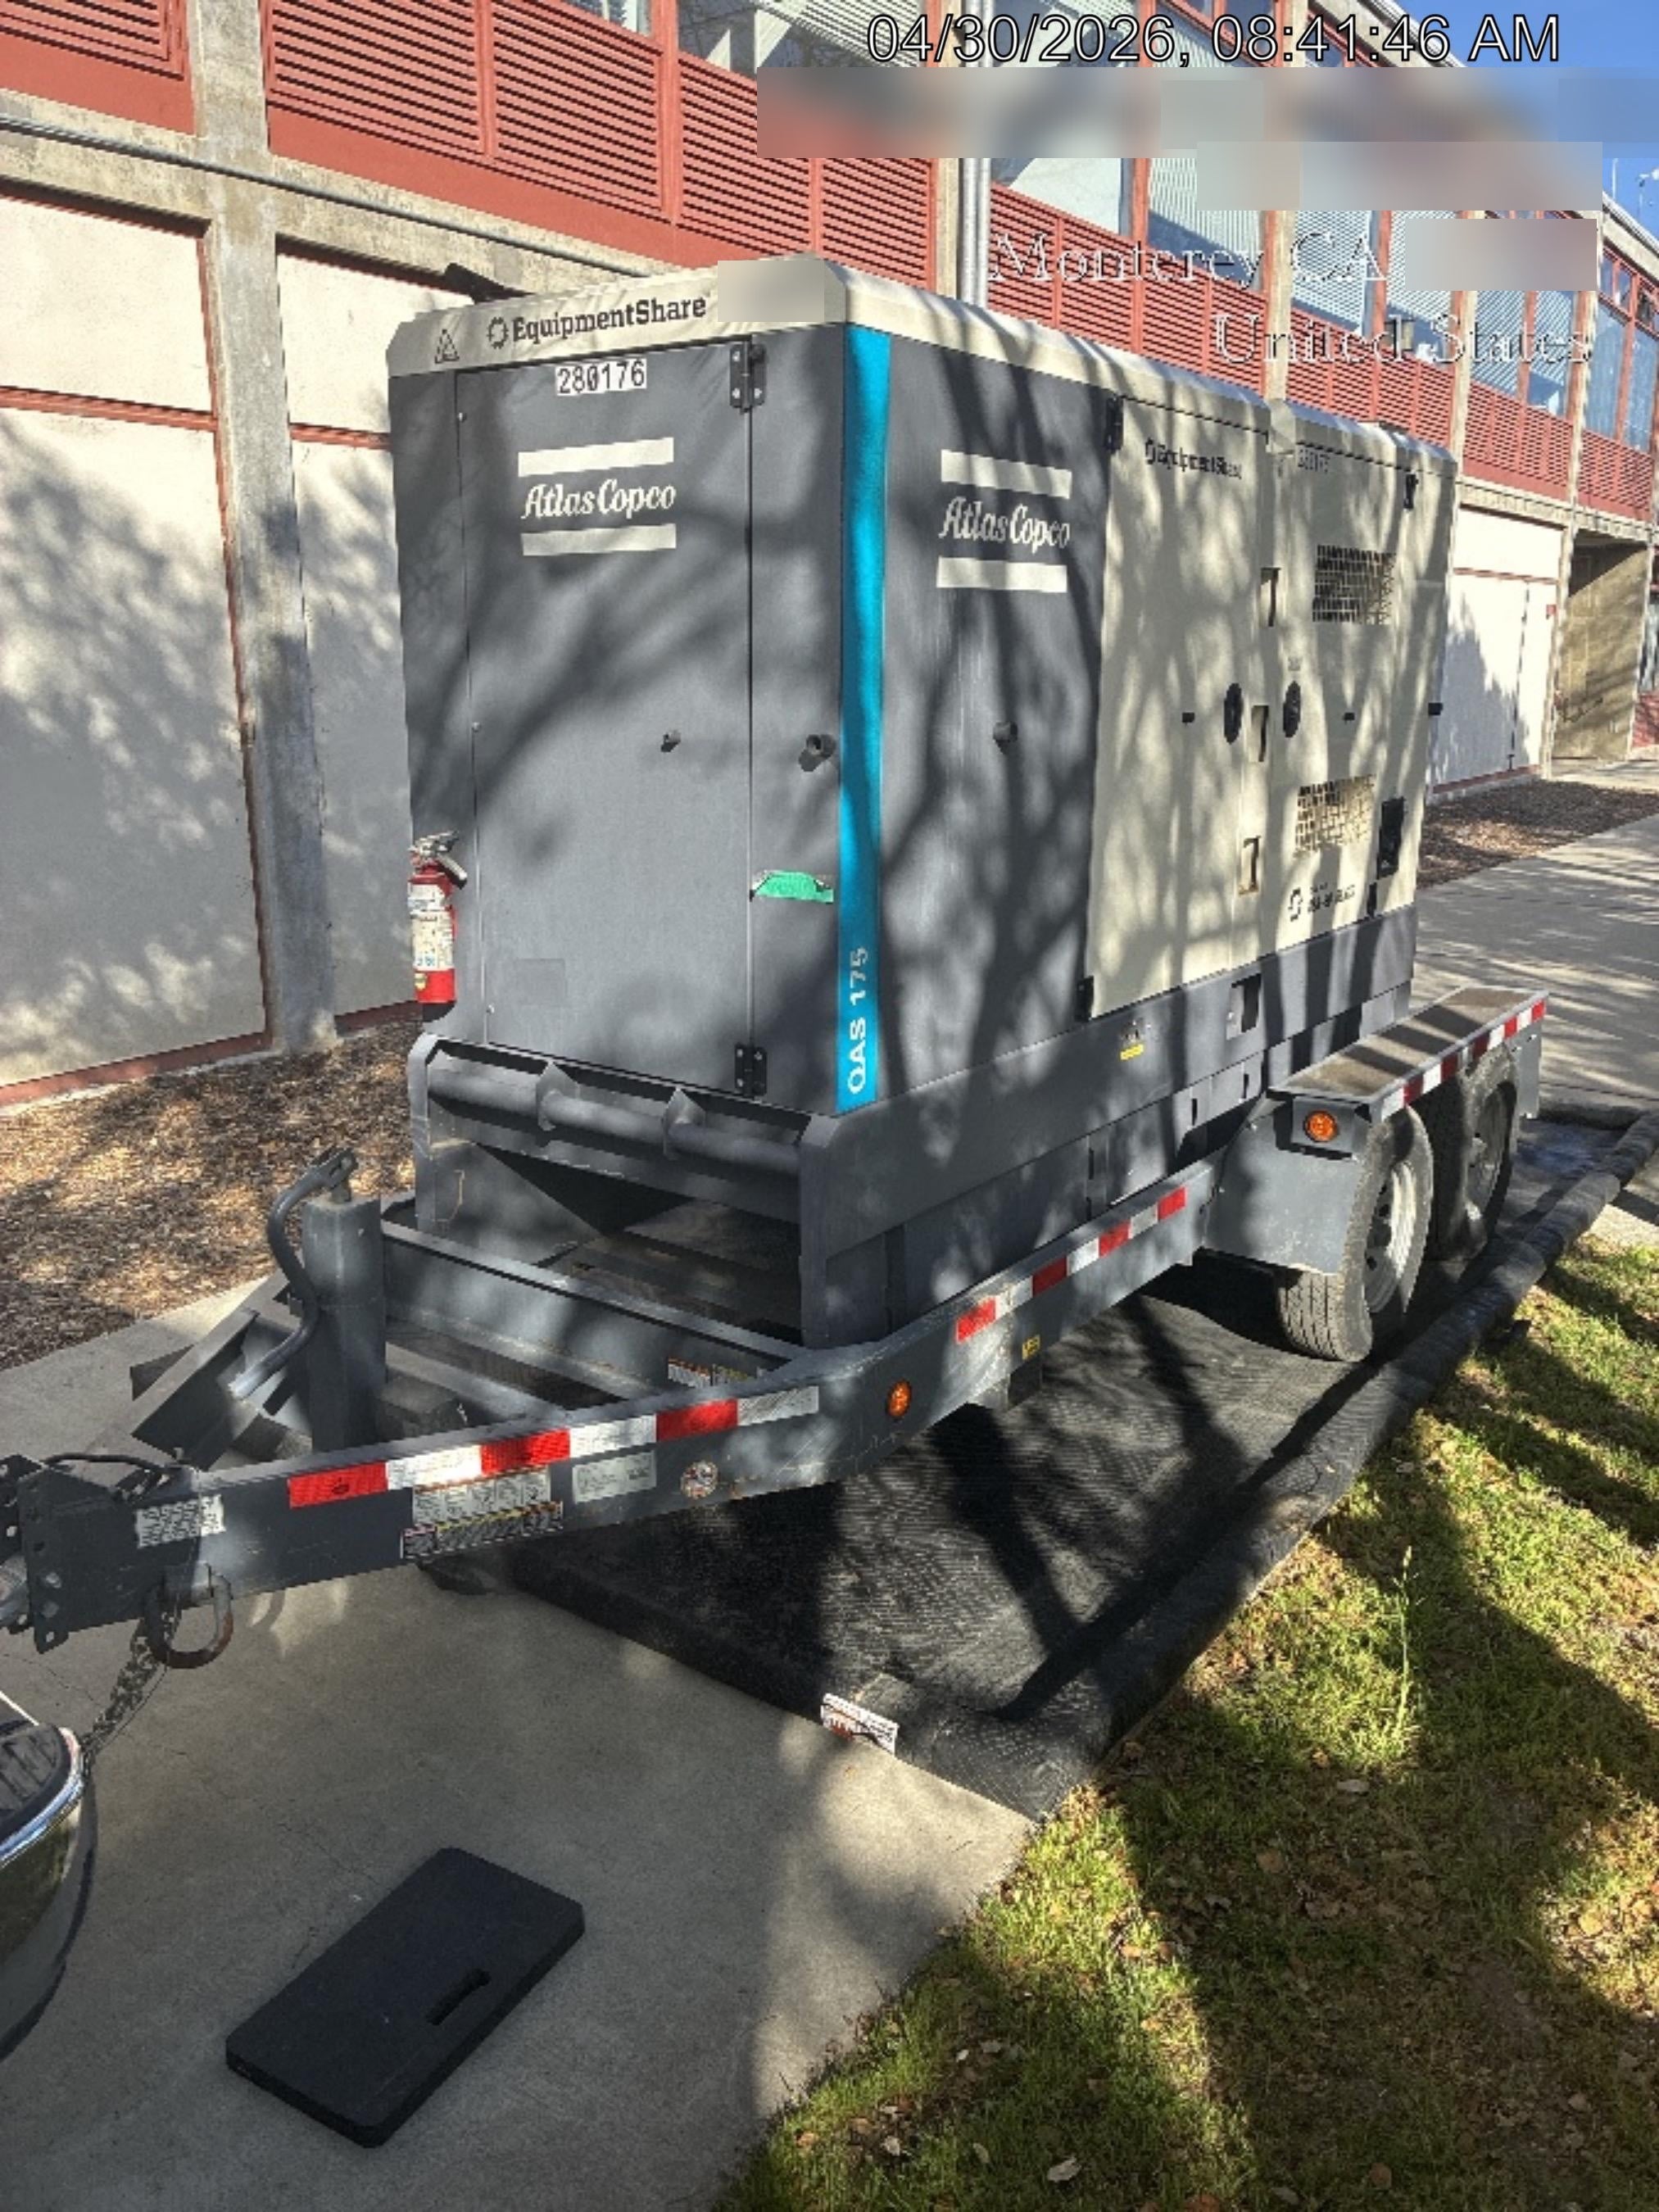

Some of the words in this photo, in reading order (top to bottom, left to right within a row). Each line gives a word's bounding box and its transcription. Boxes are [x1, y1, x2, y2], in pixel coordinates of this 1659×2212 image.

[511, 297, 707, 345] EquipmentShare
[557, 359, 645, 394] 280176
[850, 947, 868, 1006] 175
[847, 1017, 867, 1095] QAS
